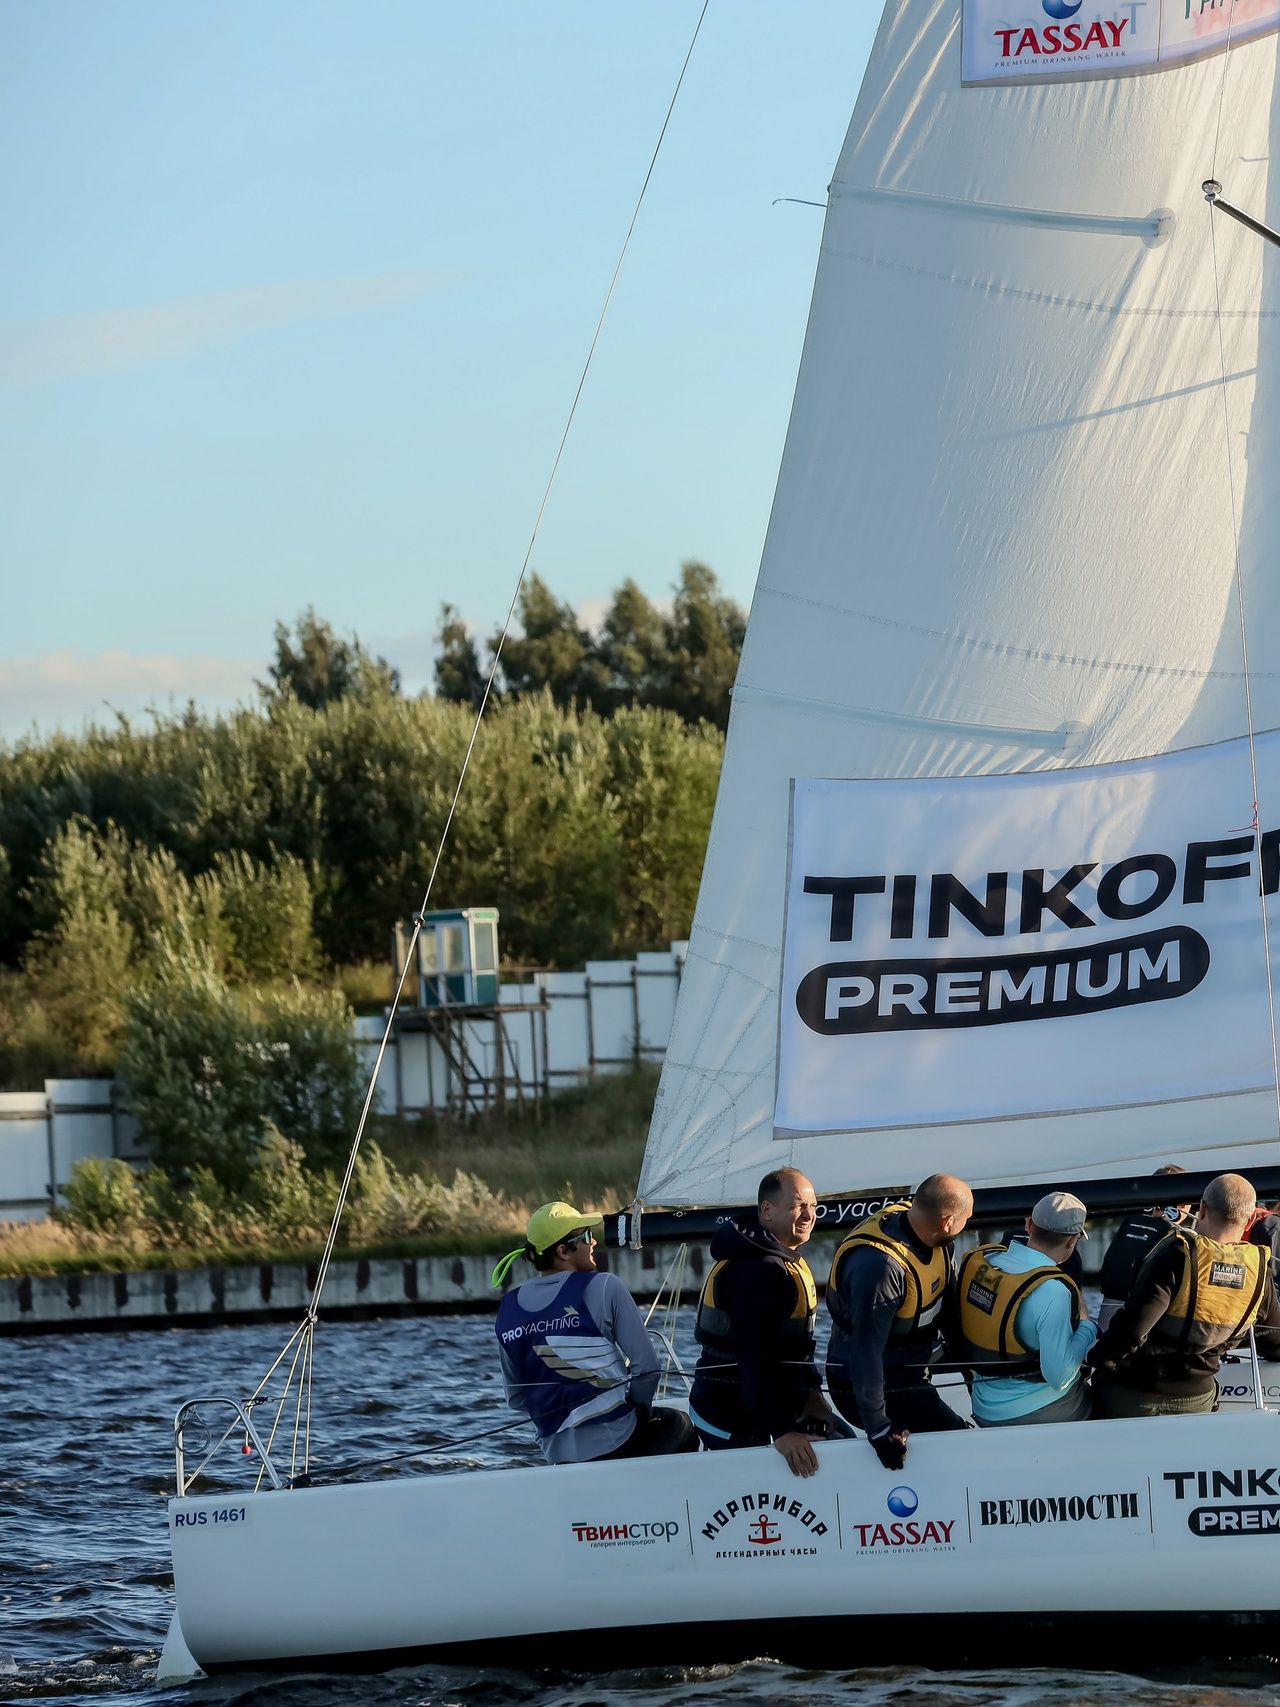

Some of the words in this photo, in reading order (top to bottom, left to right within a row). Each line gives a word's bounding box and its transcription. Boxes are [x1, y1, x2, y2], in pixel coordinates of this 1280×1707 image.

[993, 18, 1129, 57] TASSAY
[994, 58, 1038, 67] PREMIUM
[1042, 54, 1091, 64] DRINKING
[1096, 50, 1127, 59] WATER
[824, 939, 1182, 1020] PREMIUM
[1214, 1264, 1243, 1275] MARINE
[971, 1283, 994, 1301] MARINE
[501, 1316, 580, 1343] PROYACHTING
[175, 1511, 208, 1527] RUS
[212, 1507, 246, 1524] 1461
[701, 1493, 828, 1541] МОРПРИБОР
[978, 1493, 1139, 1528] ВЕДОМОСТИ
[590, 1541, 616, 1549] галерея
[617, 1538, 656, 1547] интерьеров
[852, 1520, 956, 1547] TASSAY
[715, 1549, 786, 1559] ЛЕГЕНДАРНЫЕ
[790, 1547, 817, 1556] ЧАСЫ
